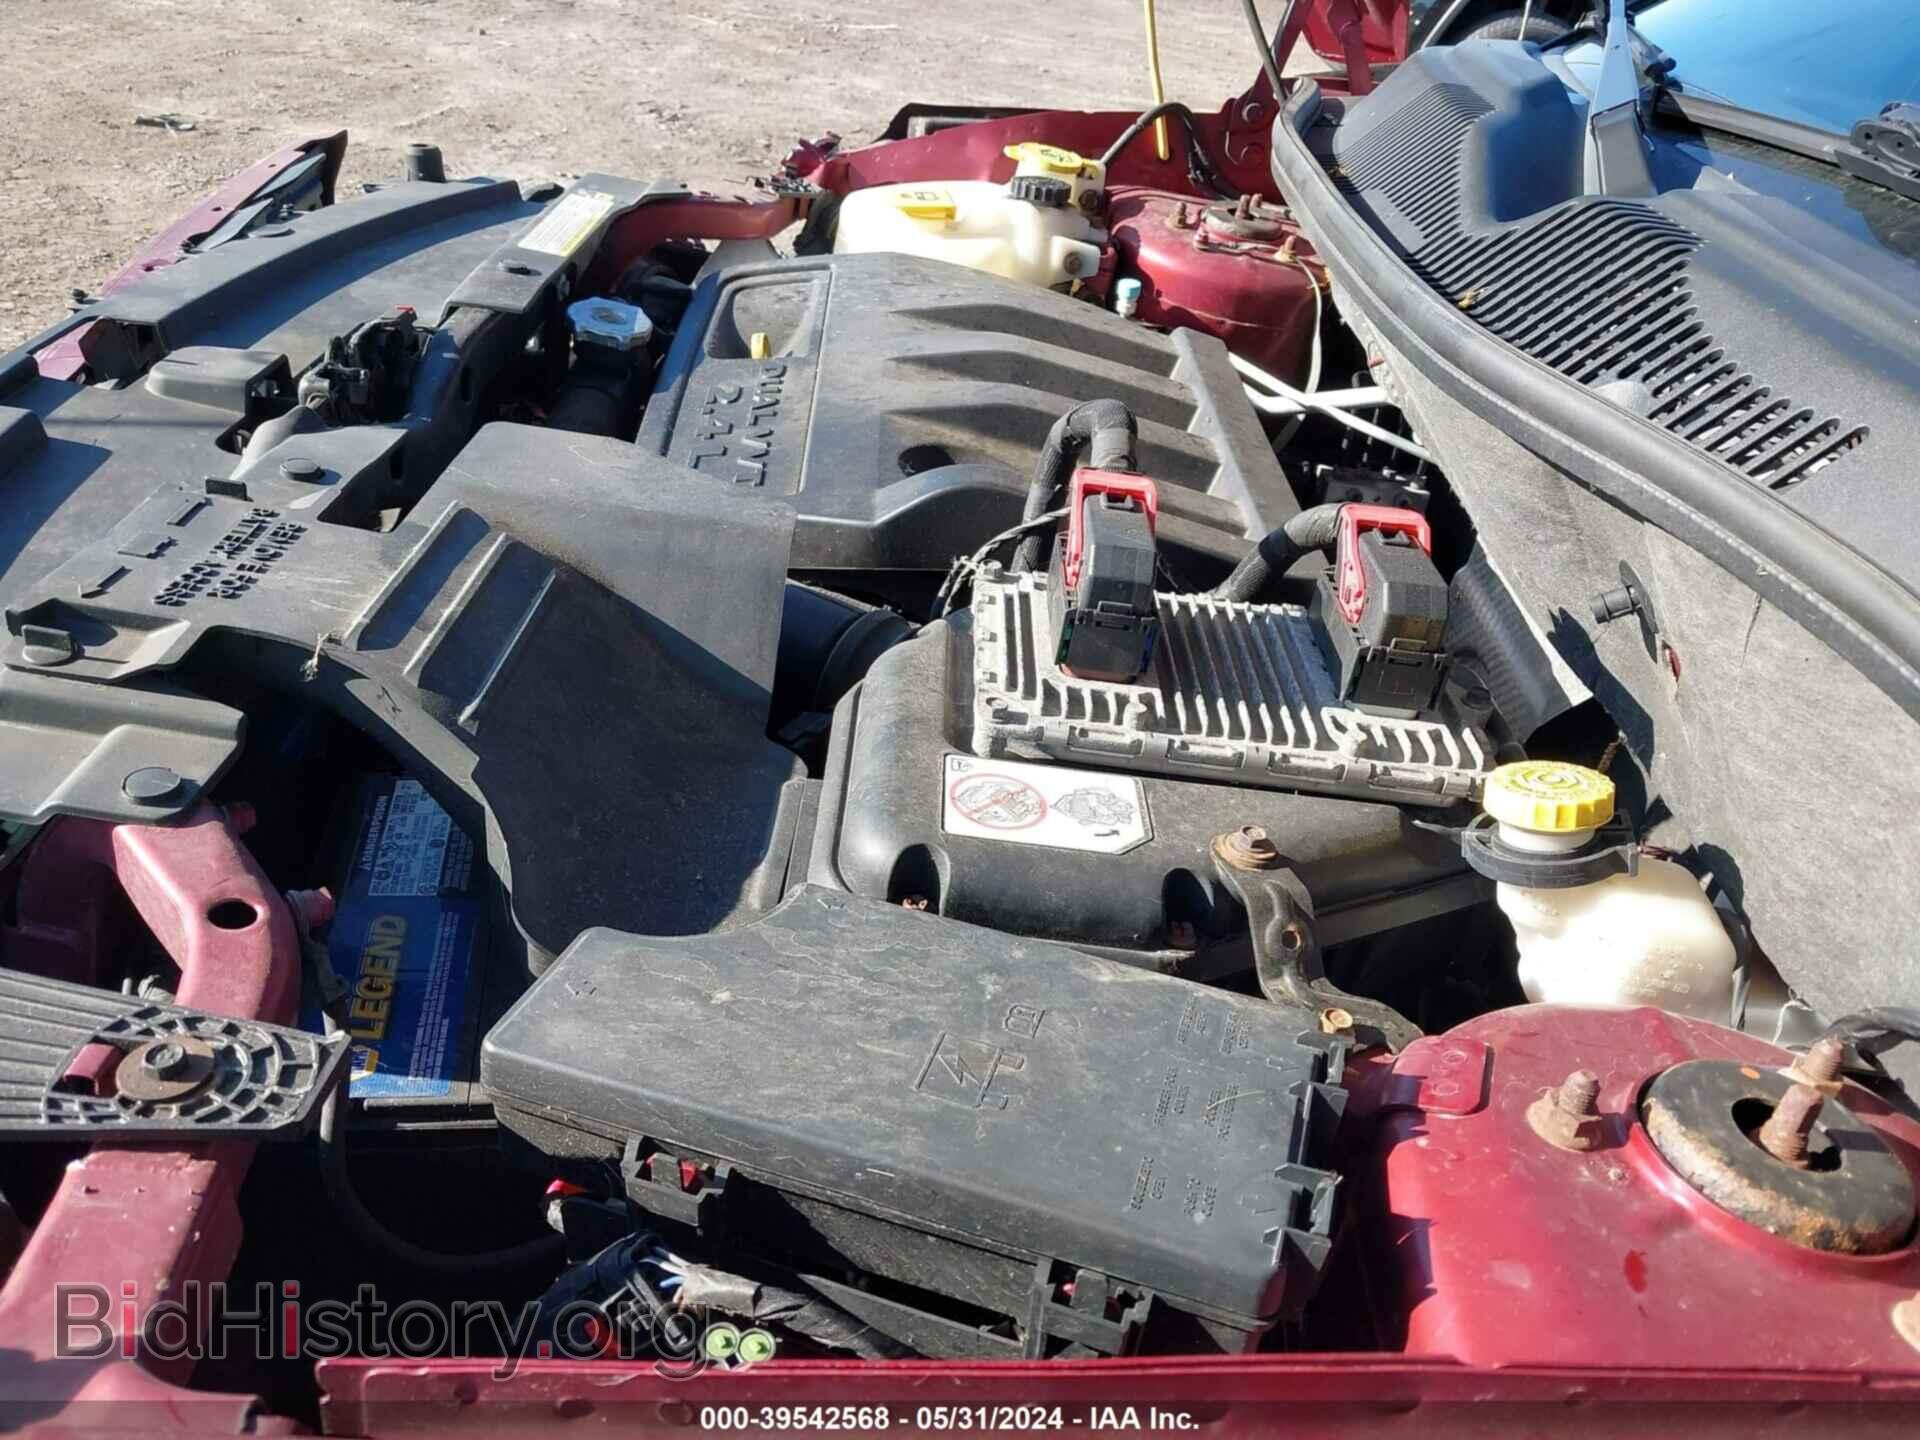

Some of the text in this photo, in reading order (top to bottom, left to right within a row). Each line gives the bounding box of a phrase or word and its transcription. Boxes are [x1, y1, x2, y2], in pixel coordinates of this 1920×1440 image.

[732, 364, 788, 487] DUAL VVT
[153, 507, 281, 607] BATTERY ACCESS
[235, 522, 309, 574] REMOVE
[350, 913, 407, 1040] LEGEND
